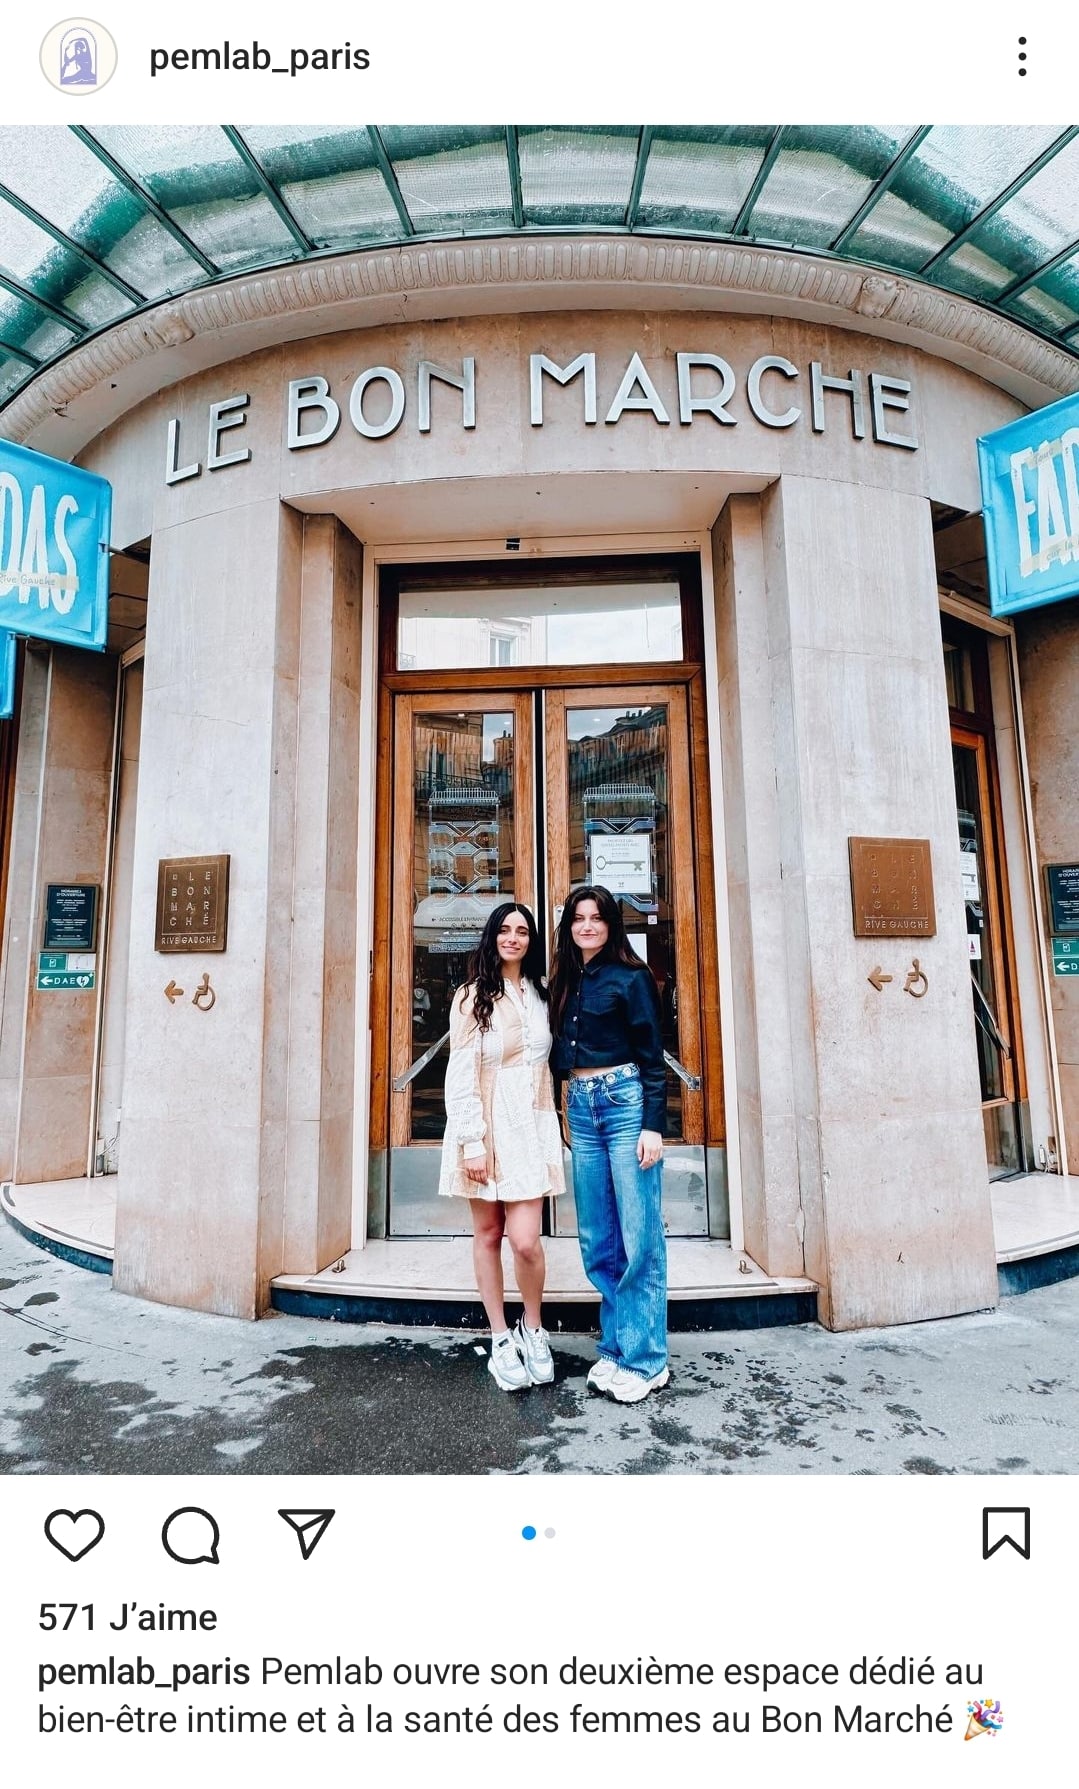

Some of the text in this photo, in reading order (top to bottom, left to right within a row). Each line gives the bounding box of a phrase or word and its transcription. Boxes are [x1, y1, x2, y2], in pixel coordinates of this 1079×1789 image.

[165, 351, 920, 486] LE BON MARCHE
[865, 920, 929, 929] RIVE GAUCHE
[181, 936, 217, 945] GAUCHE
[54, 977, 76, 985] DAE
